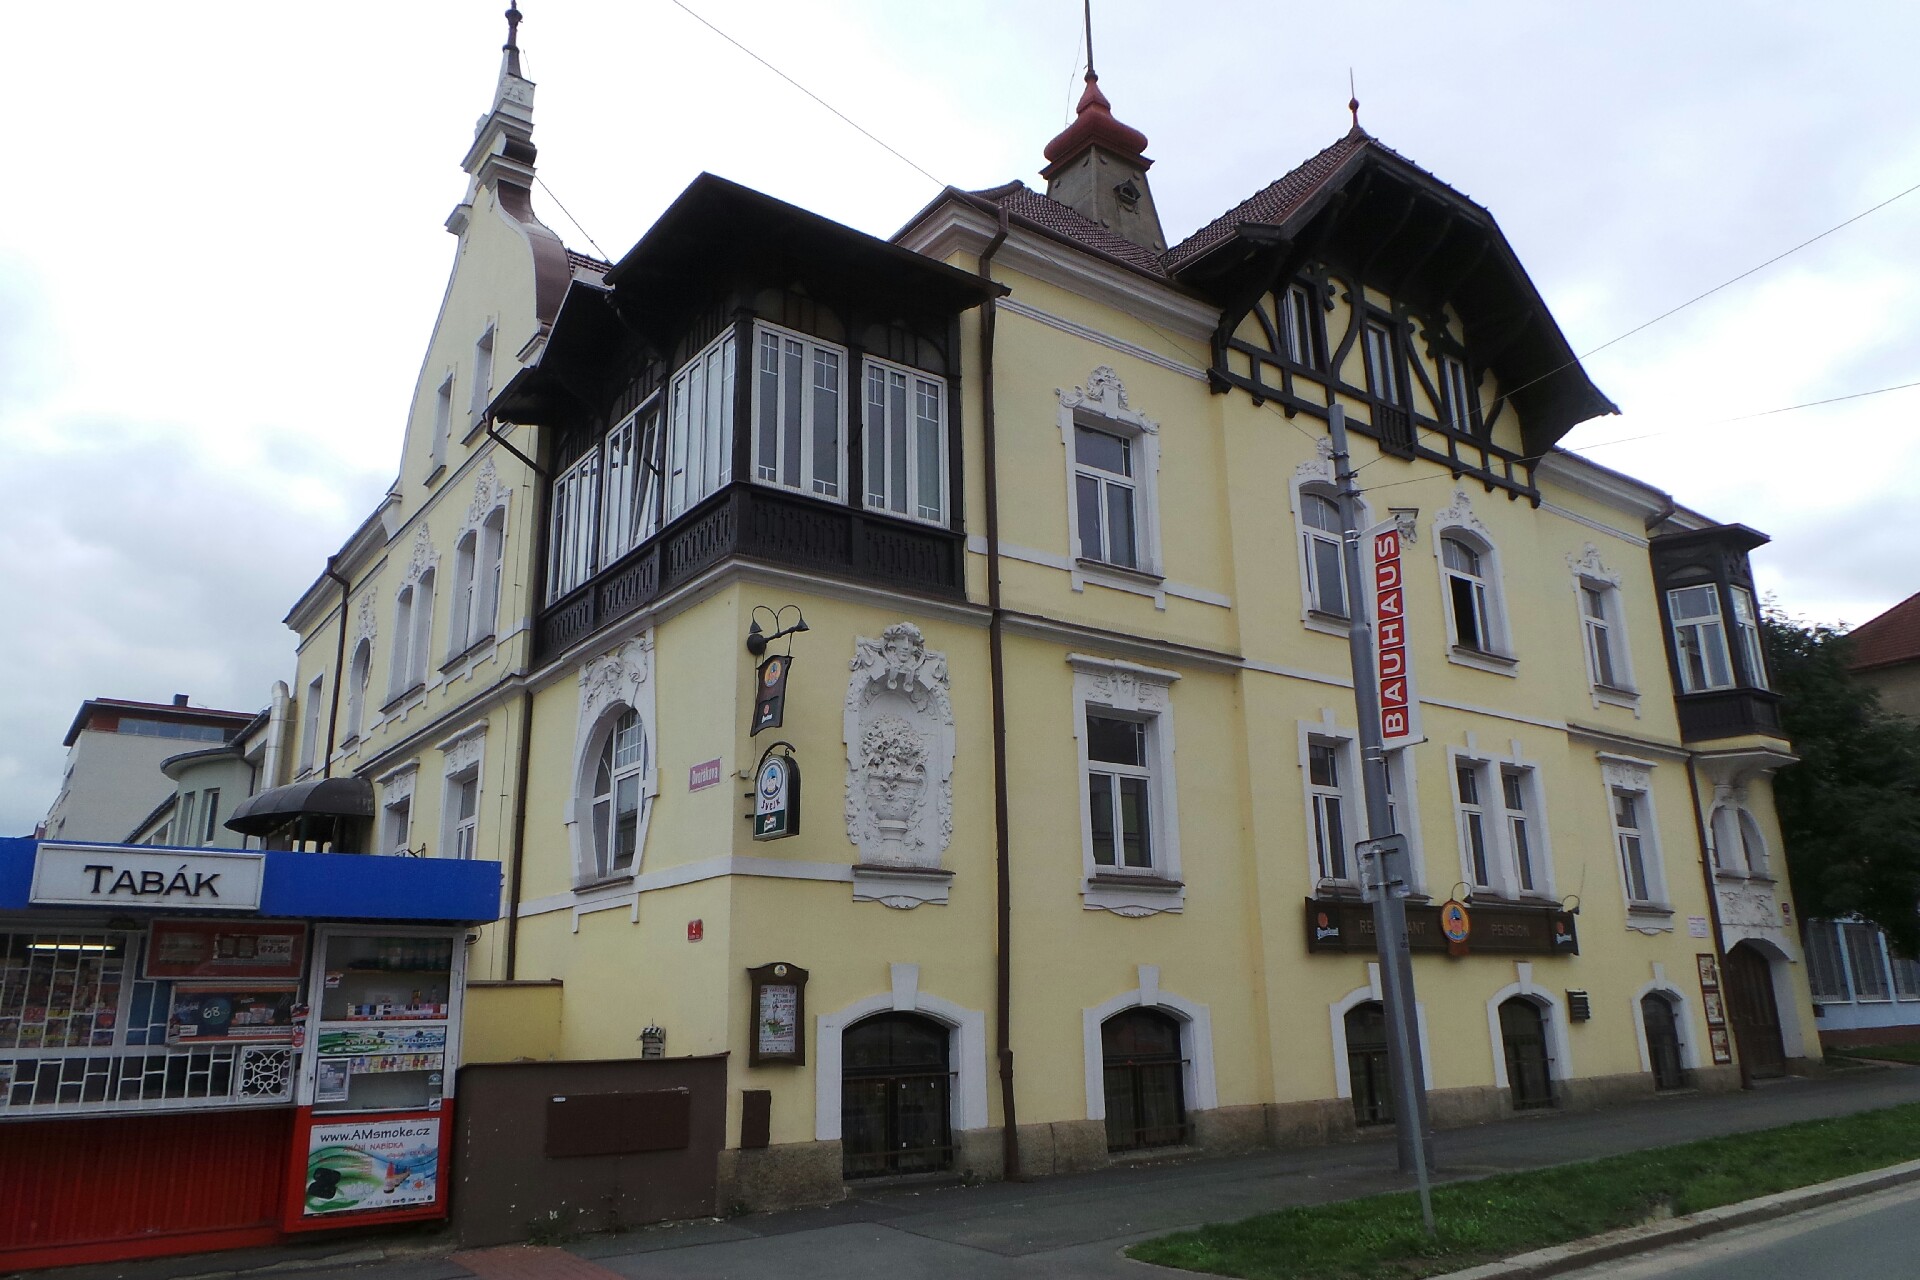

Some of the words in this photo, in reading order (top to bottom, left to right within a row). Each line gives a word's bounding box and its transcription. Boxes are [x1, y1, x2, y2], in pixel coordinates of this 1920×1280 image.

[1377, 534, 1405, 734] BAUHAUS
[691, 766, 718, 787] Dvořákova
[84, 864, 221, 898] TABÁK
[1491, 923, 1530, 937] PENSION
[320, 1127, 431, 1142] www.AMsmoke.cz
[369, 1141, 404, 1151] NABÍDKA
